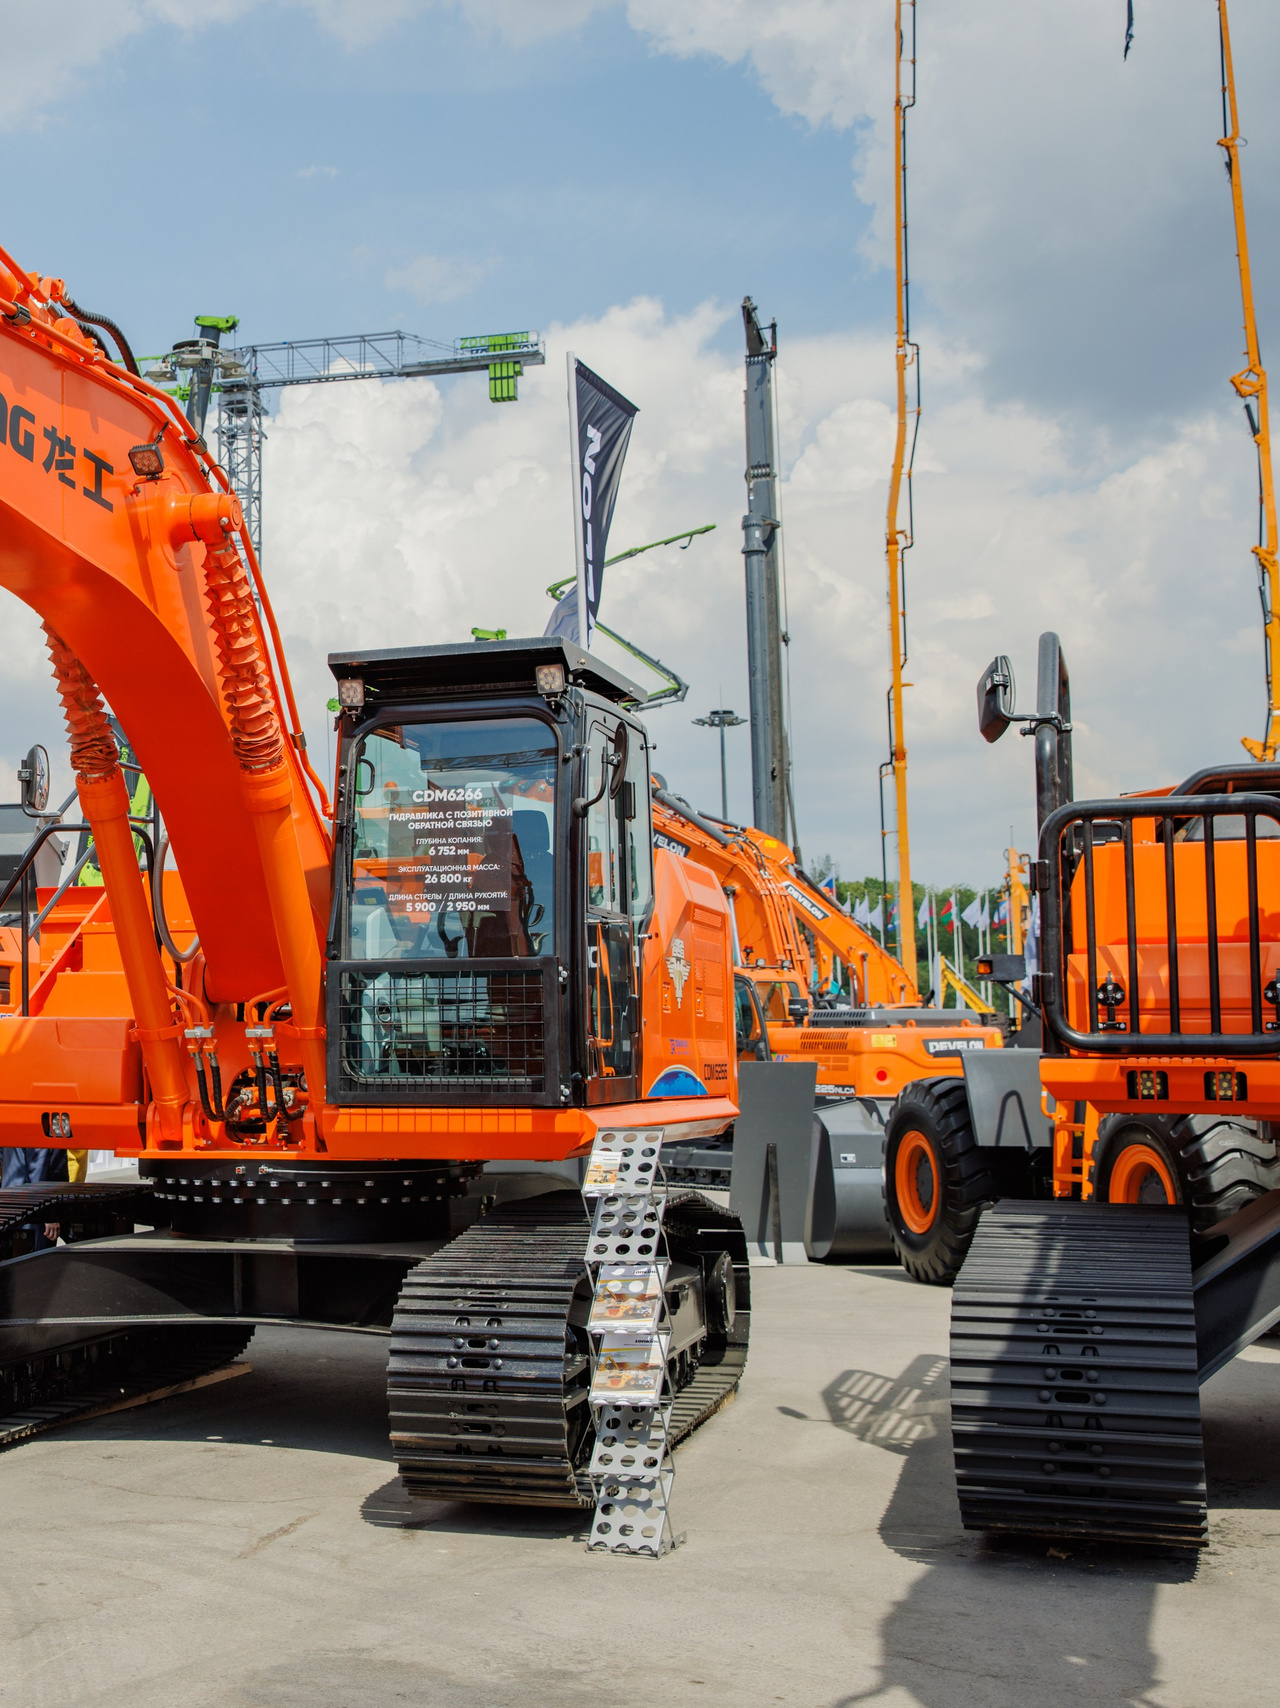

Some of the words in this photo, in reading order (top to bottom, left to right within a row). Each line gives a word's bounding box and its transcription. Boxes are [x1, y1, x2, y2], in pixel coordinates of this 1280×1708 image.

[460, 332, 529, 349] ZOOMON
[41, 425, 114, 513] 龙工
[412, 788, 483, 803] CDM6266
[389, 811, 444, 821] ГИДРАВЛИКА
[446, 811, 452, 819] С
[454, 808, 513, 818] ПОЗИТИВНОЙ
[408, 820, 453, 830] ОБРАТНОЙ
[456, 819, 492, 828] СВЯЗЬЮ
[398, 865, 471, 873] ЭКСПЛУАТАЦИОННАЯ
[448, 892, 473, 900] ДЛИНА
[787, 886, 824, 920] DEVELON
